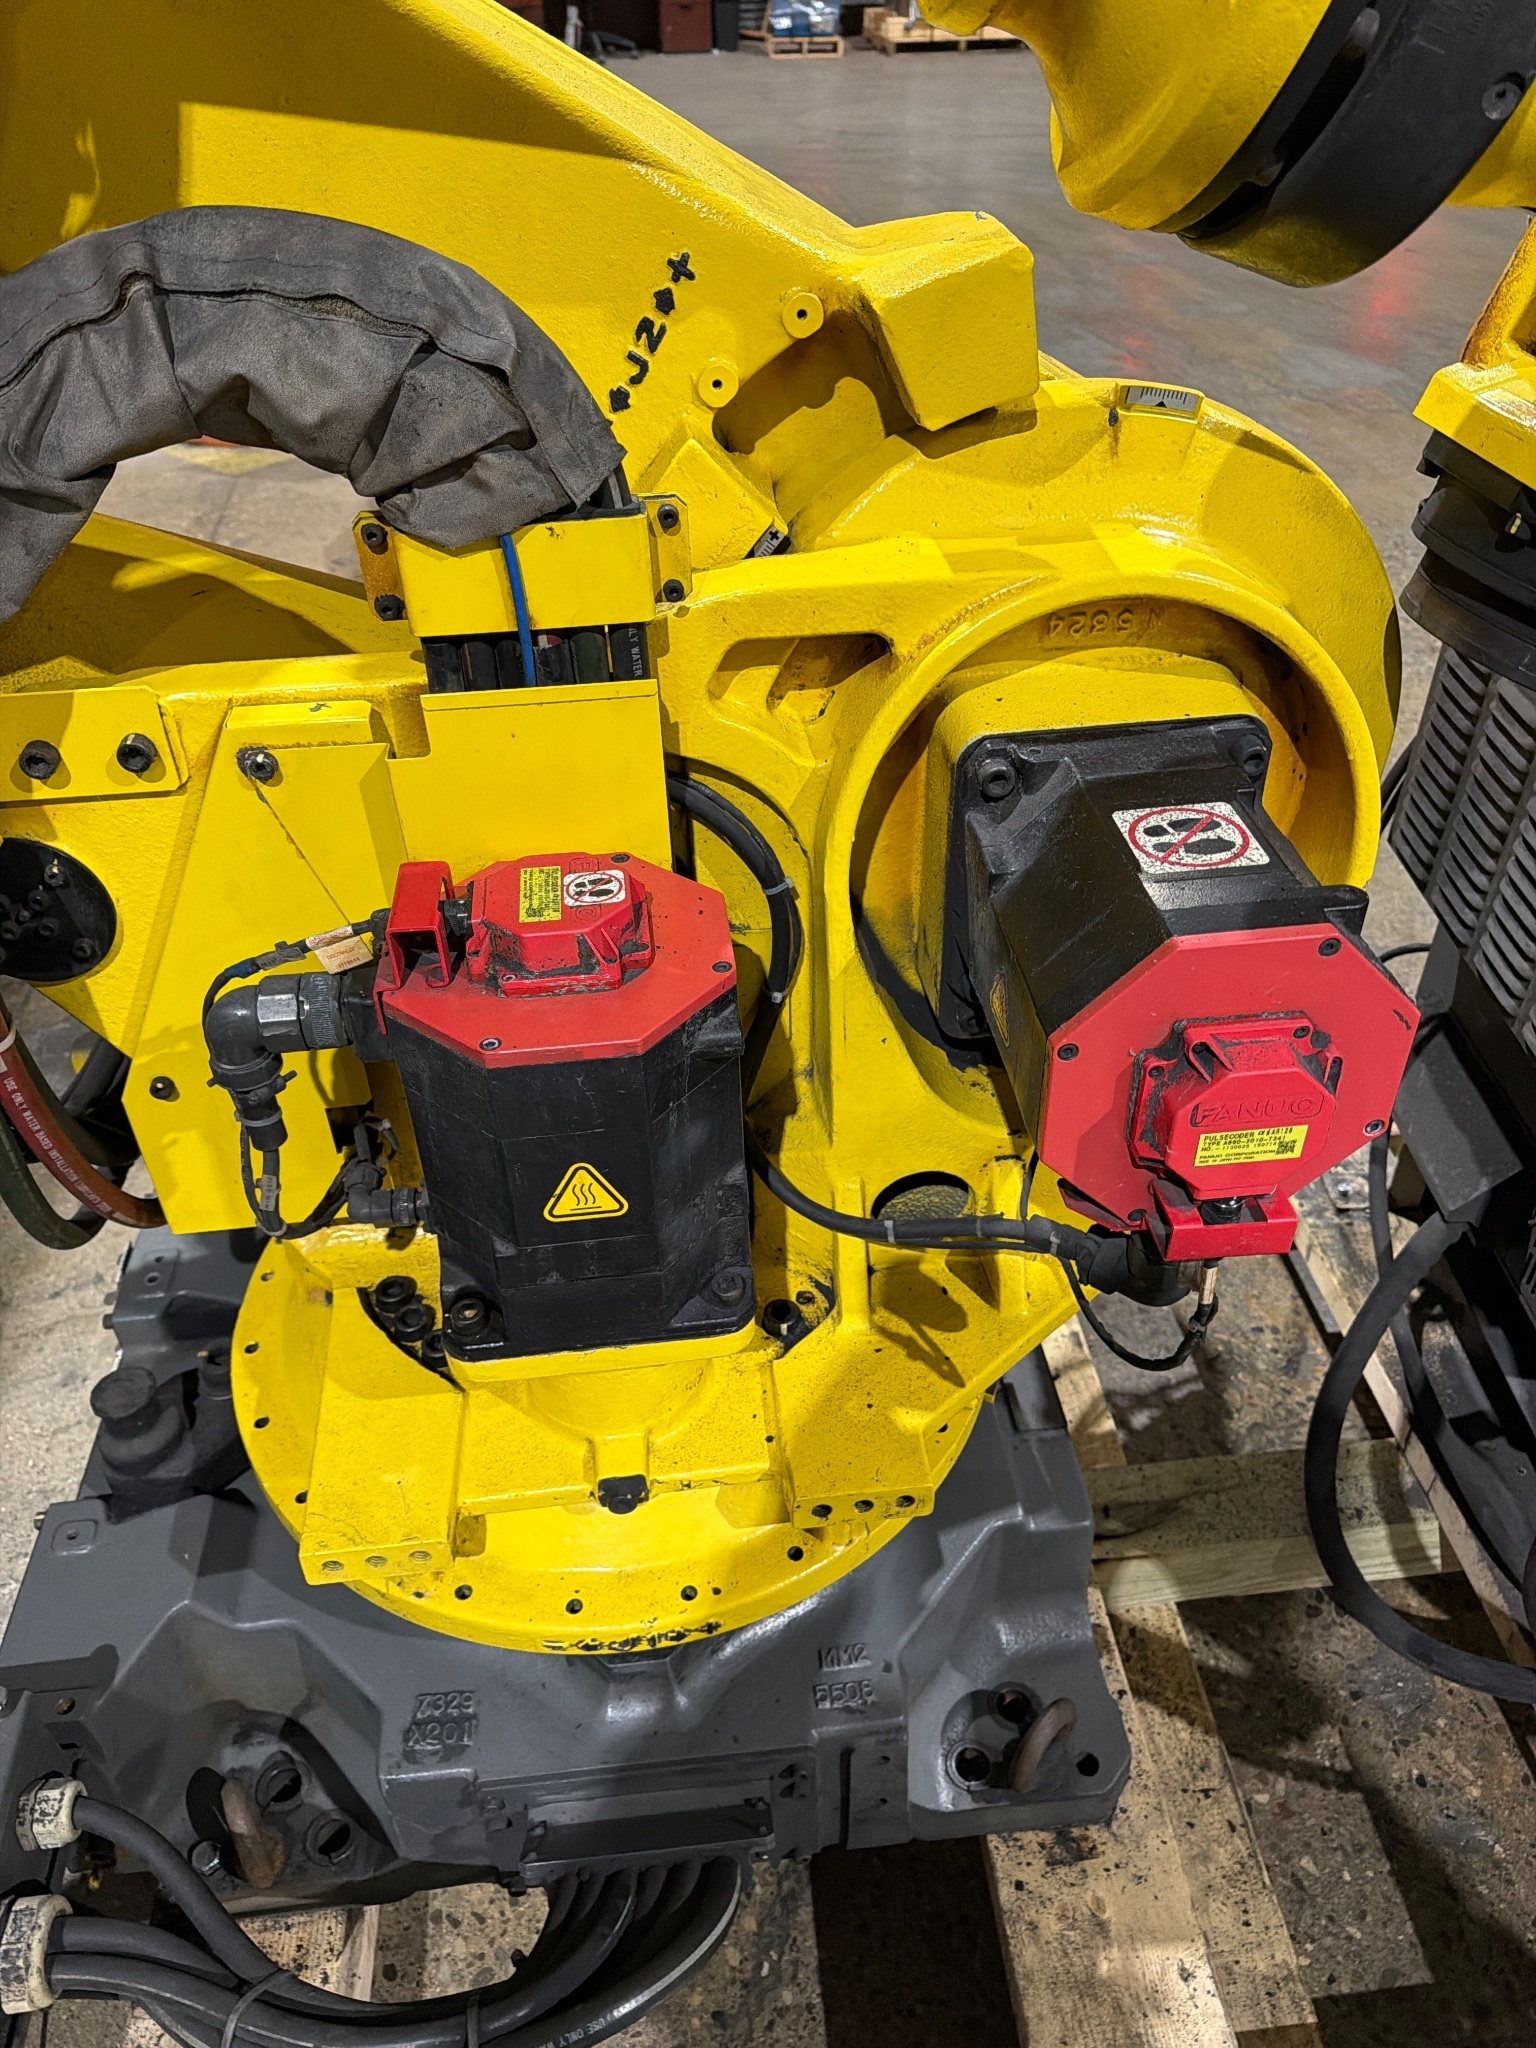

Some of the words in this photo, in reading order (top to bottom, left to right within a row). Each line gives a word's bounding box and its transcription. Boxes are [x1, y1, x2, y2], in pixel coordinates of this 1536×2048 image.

[626, 316, 668, 385] J2
[630, 645, 643, 677] WATER
[4, 1077, 18, 1092] USE
[12, 1092, 28, 1110] ONLY
[22, 1109, 41, 1132] WATER
[35, 1130, 53, 1150] BASED
[1198, 1097, 1313, 1122] FANUC
[1204, 1131, 1255, 1142] PULSECODER
[559, 2028, 585, 2048] ONLY
[587, 2017, 606, 2034] USE
